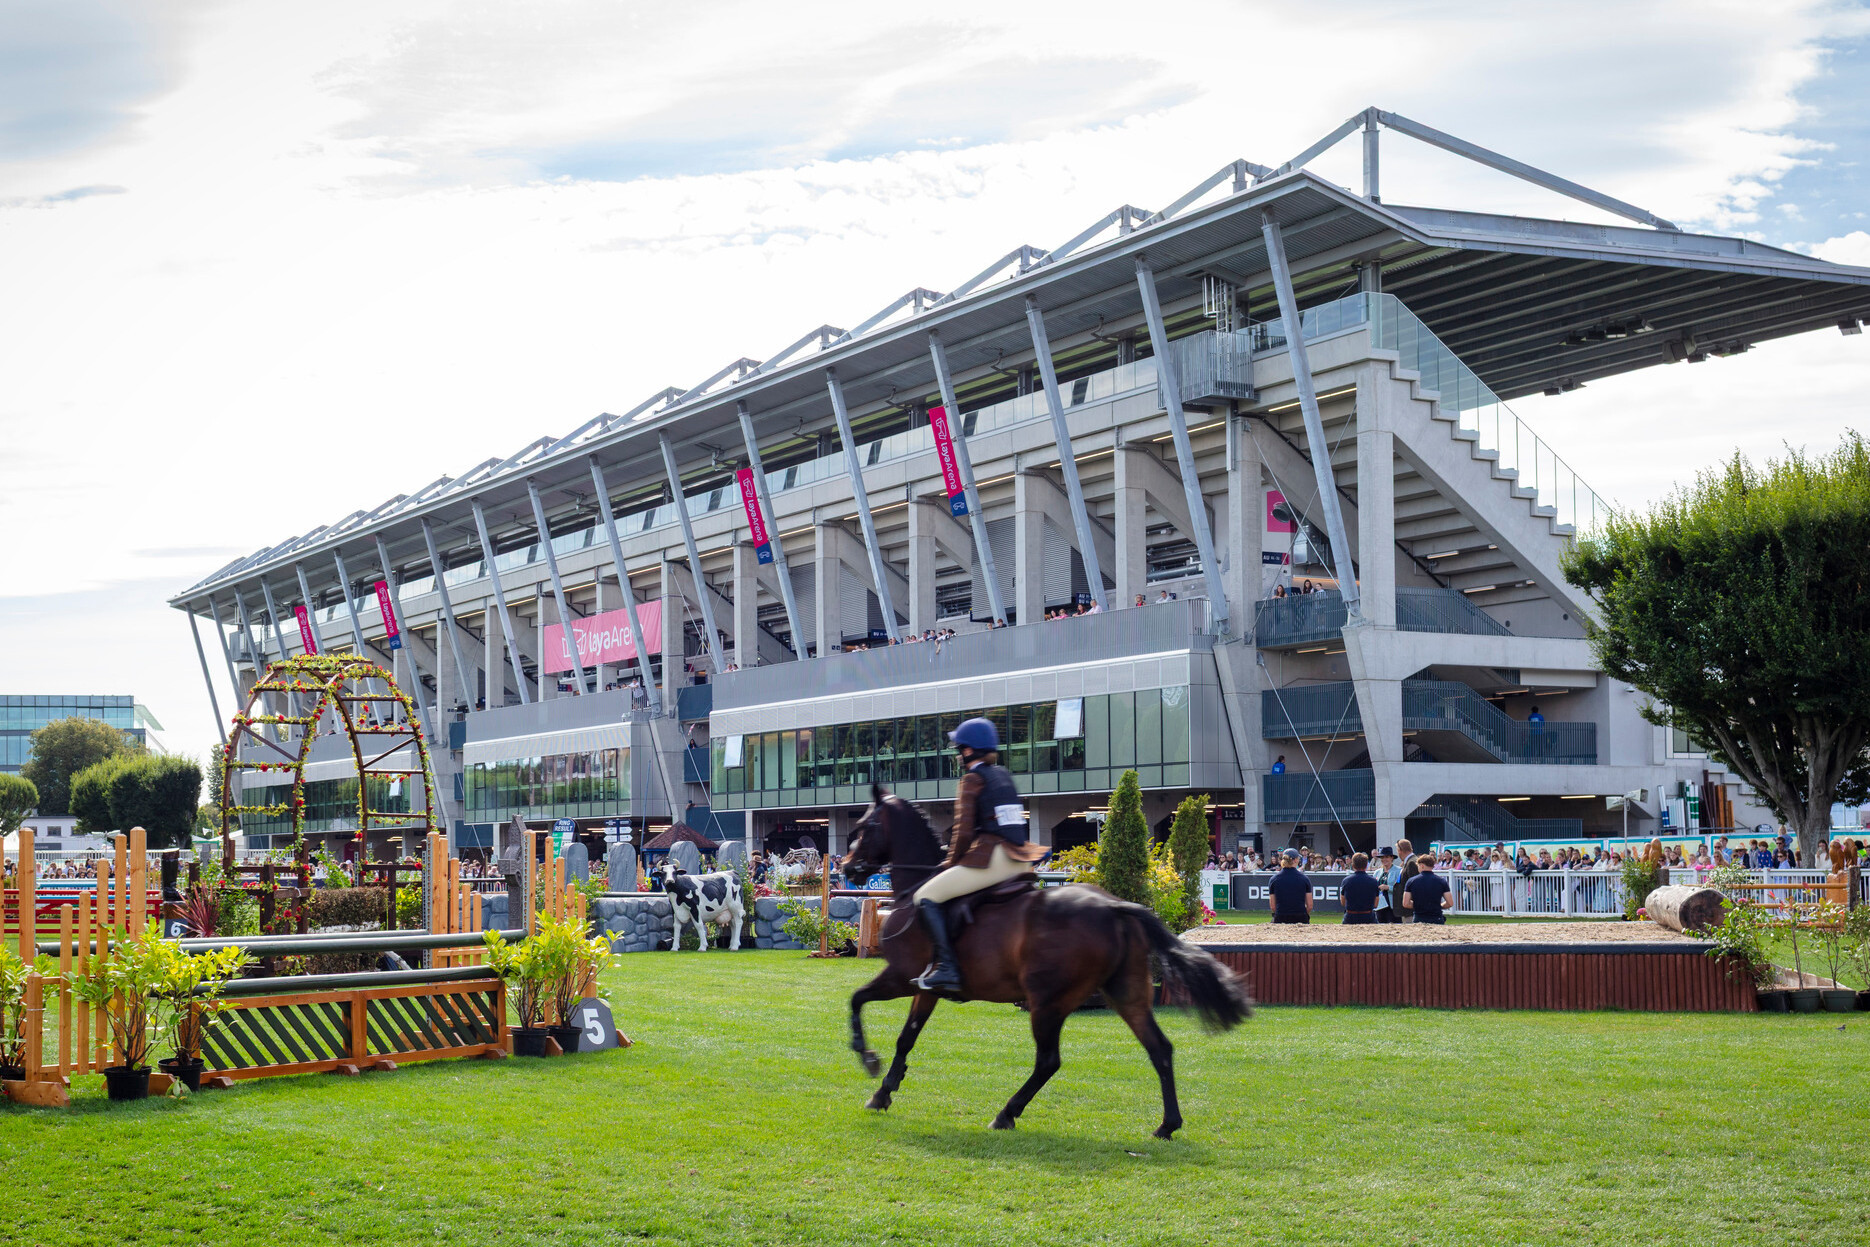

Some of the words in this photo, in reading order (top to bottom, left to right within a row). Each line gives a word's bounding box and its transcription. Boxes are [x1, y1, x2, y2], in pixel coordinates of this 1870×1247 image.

[940, 441, 957, 490] layaArena
[589, 623, 644, 656] layaAre
[170, 921, 181, 938] 6
[583, 1008, 605, 1045] 5
